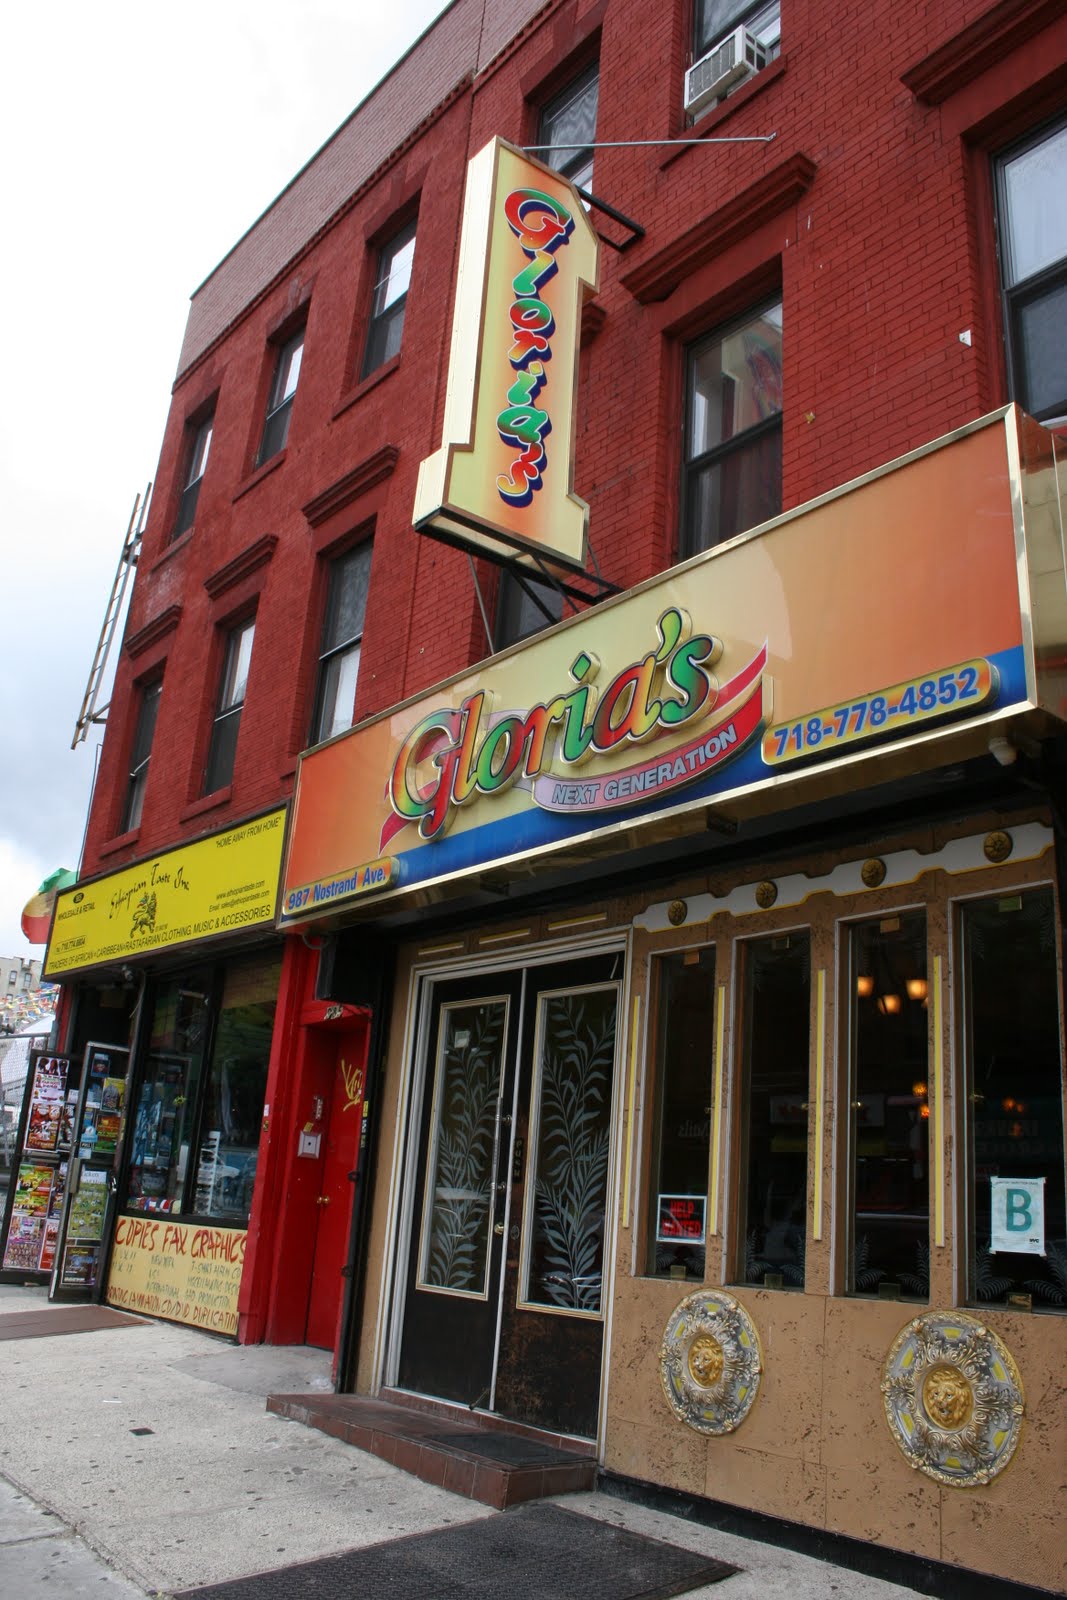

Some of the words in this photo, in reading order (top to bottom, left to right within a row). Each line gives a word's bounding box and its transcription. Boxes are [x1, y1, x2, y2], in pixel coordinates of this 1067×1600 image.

[389, 606, 718, 841] Gloria's
[773, 666, 979, 758] 718-778-4852
[552, 783, 601, 805] NEXT
[604, 723, 738, 801] GENERATION
[232, 831, 247, 844] AWAY
[246, 825, 262, 838] FROM
[151, 863, 171, 887] Taste
[288, 887, 310, 911] 987
[313, 872, 358, 903] Nostrand
[362, 865, 387, 887] Ave.
[193, 918, 214, 934] MUSIC
[214, 917, 220, 929] &
[221, 904, 271, 927] ACCESSORIES
[661, 1218, 701, 1238] WANTED
[669, 1199, 695, 1217] HELP
[1006, 1188, 1032, 1231] B
[115, 1218, 159, 1252] COPIES
[162, 1224, 188, 1256] FAX
[191, 1229, 247, 1264] GRAPHICS
